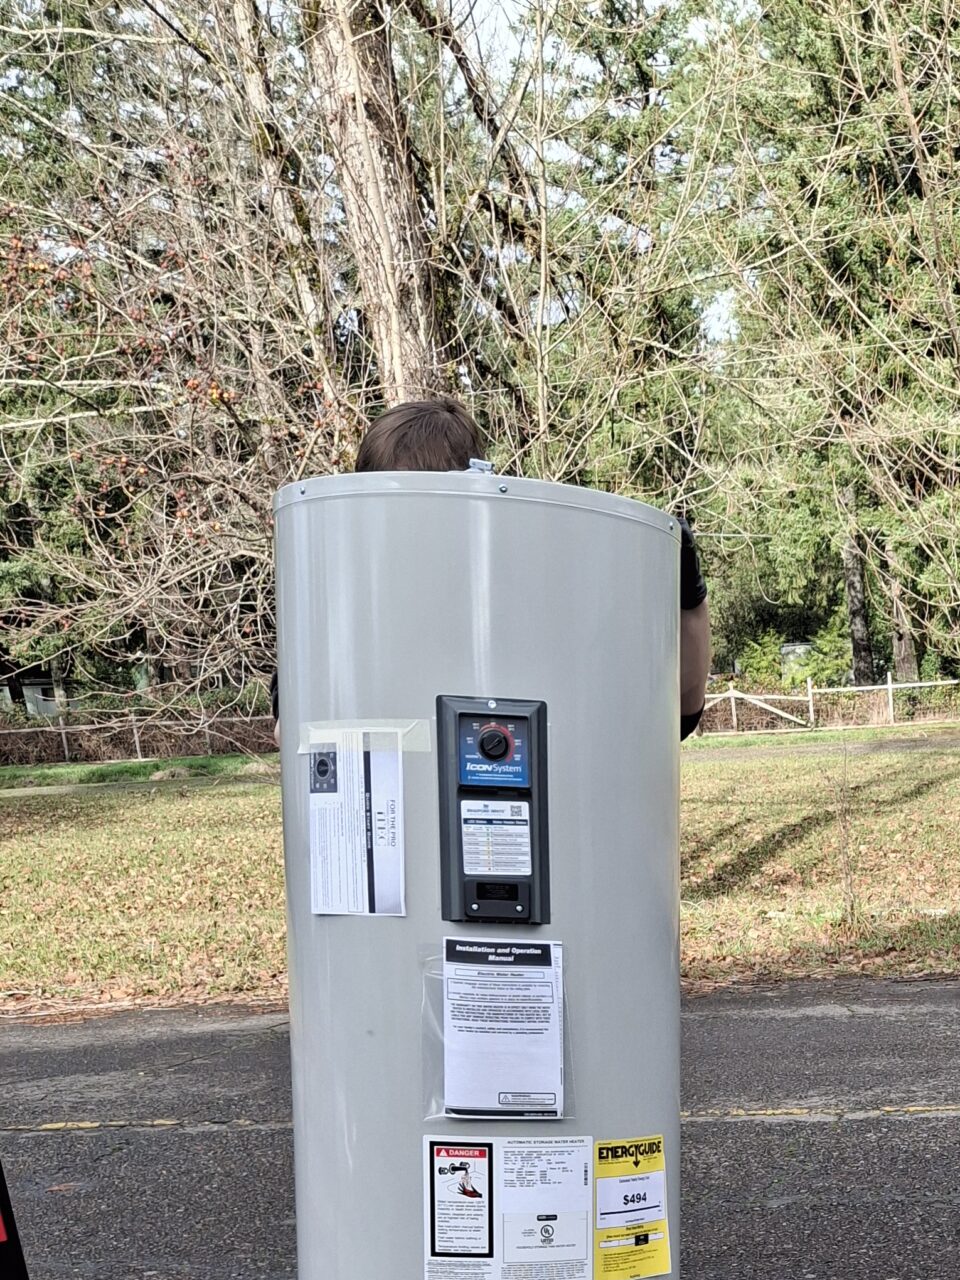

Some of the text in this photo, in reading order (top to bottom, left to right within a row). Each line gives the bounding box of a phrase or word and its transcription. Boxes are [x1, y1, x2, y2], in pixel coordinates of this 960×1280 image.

[455, 944, 495, 953] Installation
[511, 947, 541, 955] Operation
[448, 1149, 480, 1157] DANGER
[598, 1141, 662, 1160] ENERGYGUIDE
[623, 1192, 647, 1206] $494
